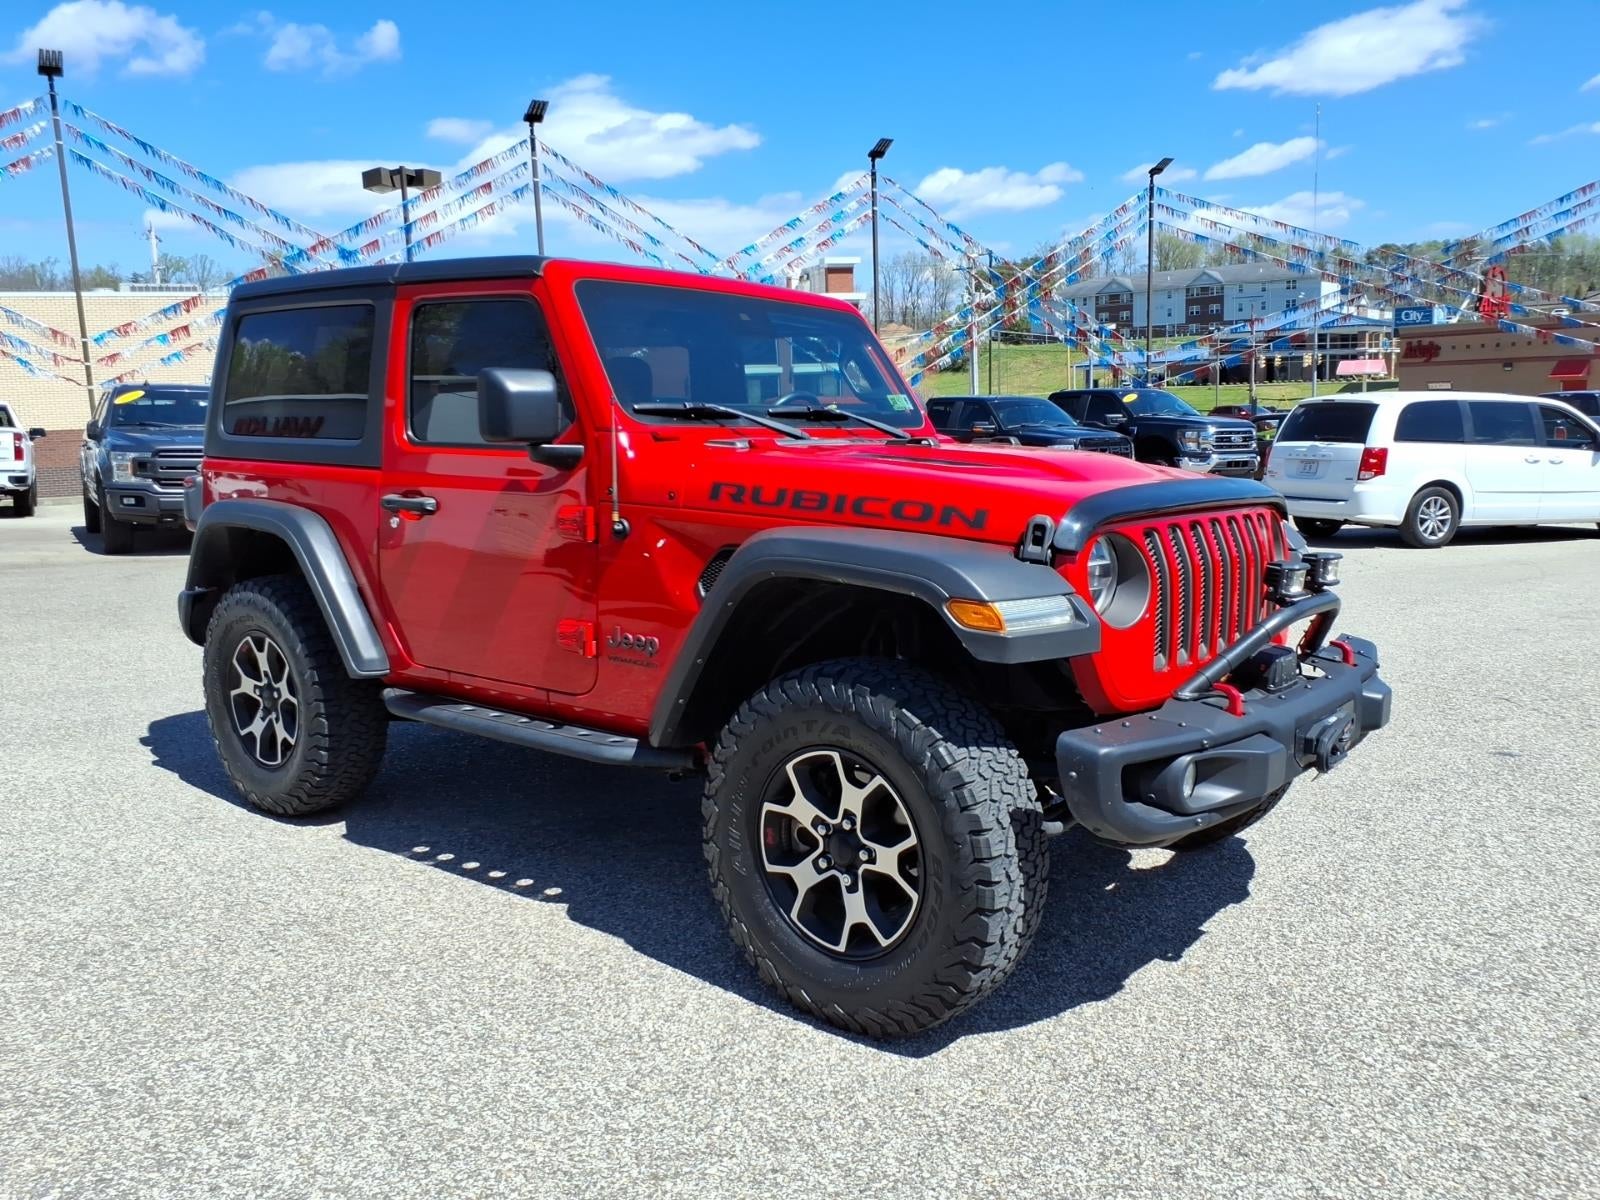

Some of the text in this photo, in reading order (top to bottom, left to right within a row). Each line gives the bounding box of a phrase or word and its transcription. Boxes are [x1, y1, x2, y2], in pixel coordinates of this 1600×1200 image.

[1401, 310, 1424, 323] City
[1401, 340, 1441, 362] Arby's
[709, 481, 989, 530] RUBICON
[606, 625, 660, 658] Jeep
